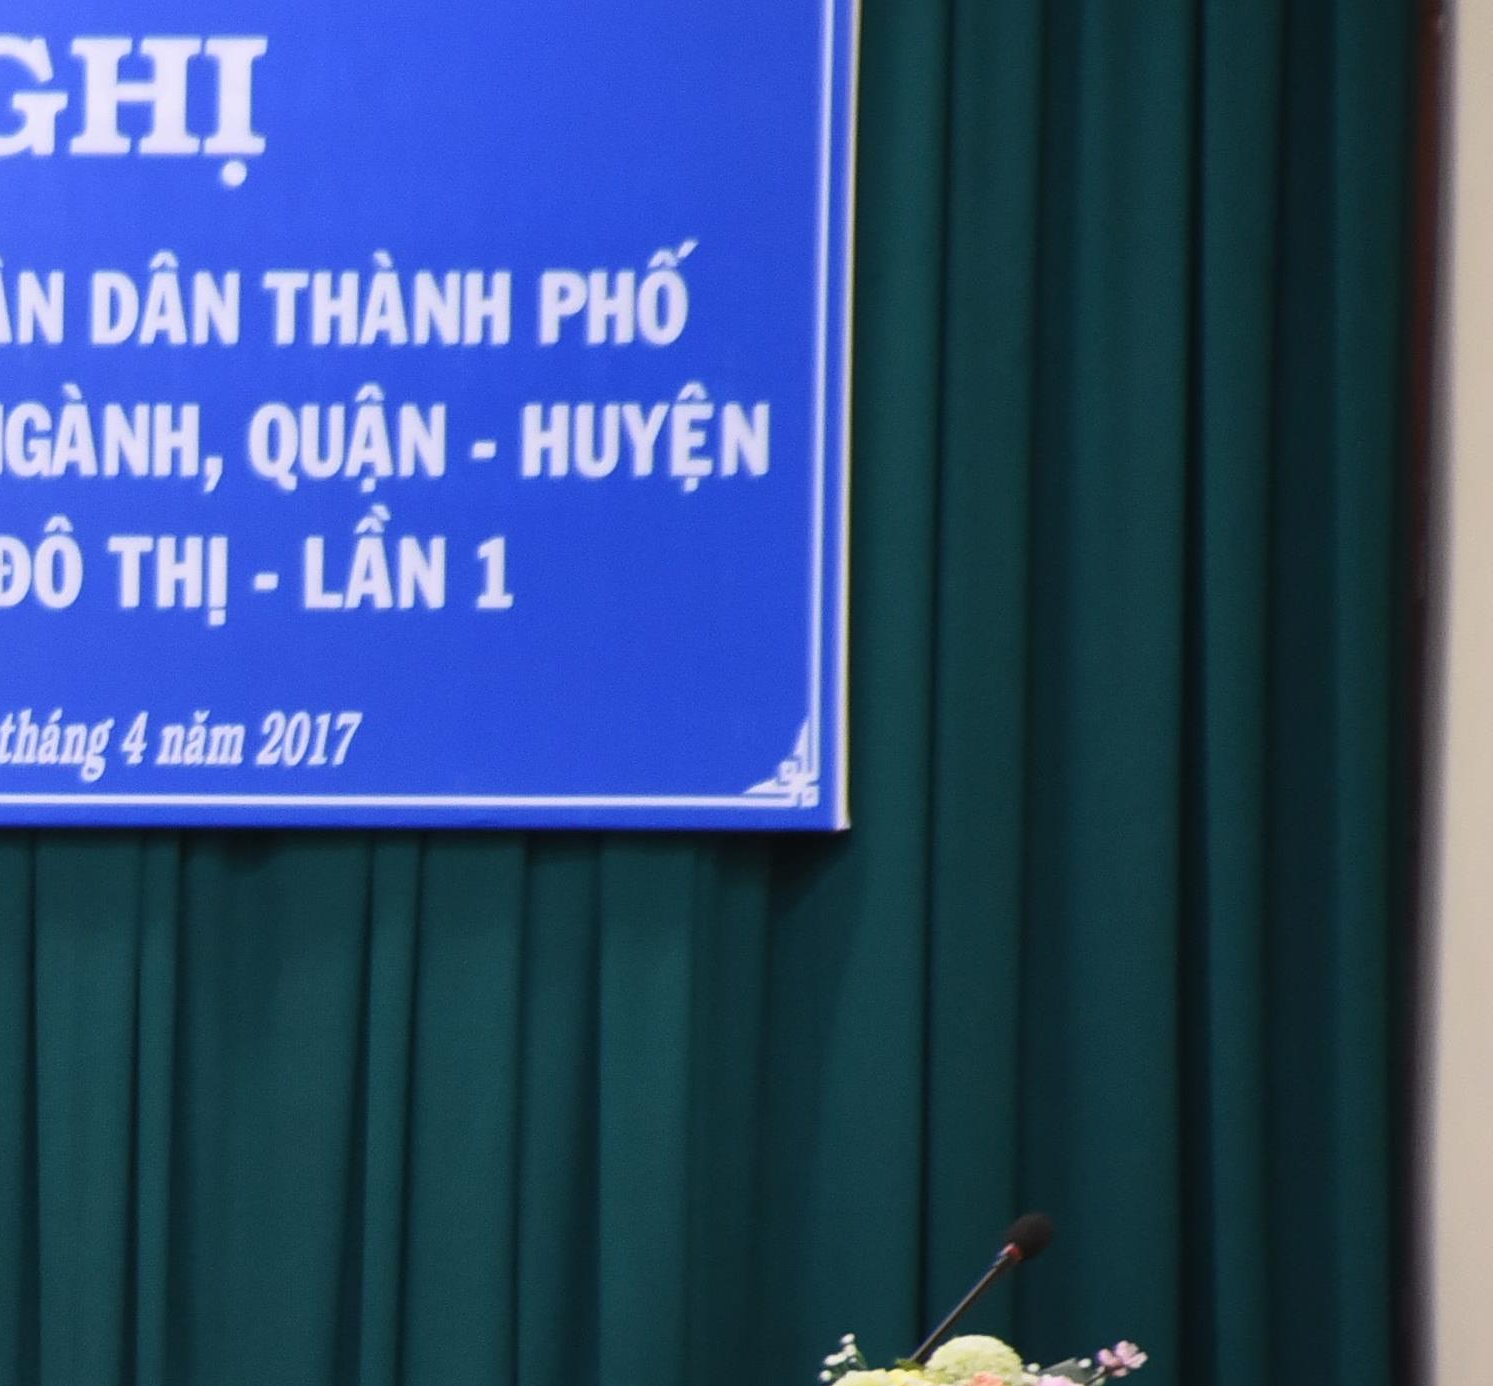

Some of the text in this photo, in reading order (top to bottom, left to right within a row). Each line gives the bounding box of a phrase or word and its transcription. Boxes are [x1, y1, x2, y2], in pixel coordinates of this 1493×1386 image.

[90, 250, 240, 346] DÂN
[263, 250, 511, 346] THÀNH
[539, 238, 698, 346] PHỐ
[248, 382, 446, 493] QUẬN
[471, 440, 497, 459] -
[521, 381, 770, 492] HUYỆN
[107, 535, 228, 627] THỊ
[253, 571, 279, 591] -
[304, 504, 446, 609] LẦN
[475, 536, 513, 609] 1
[120, 711, 150, 766] 4
[155, 710, 246, 767] năm
[254, 710, 363, 768] 2017
